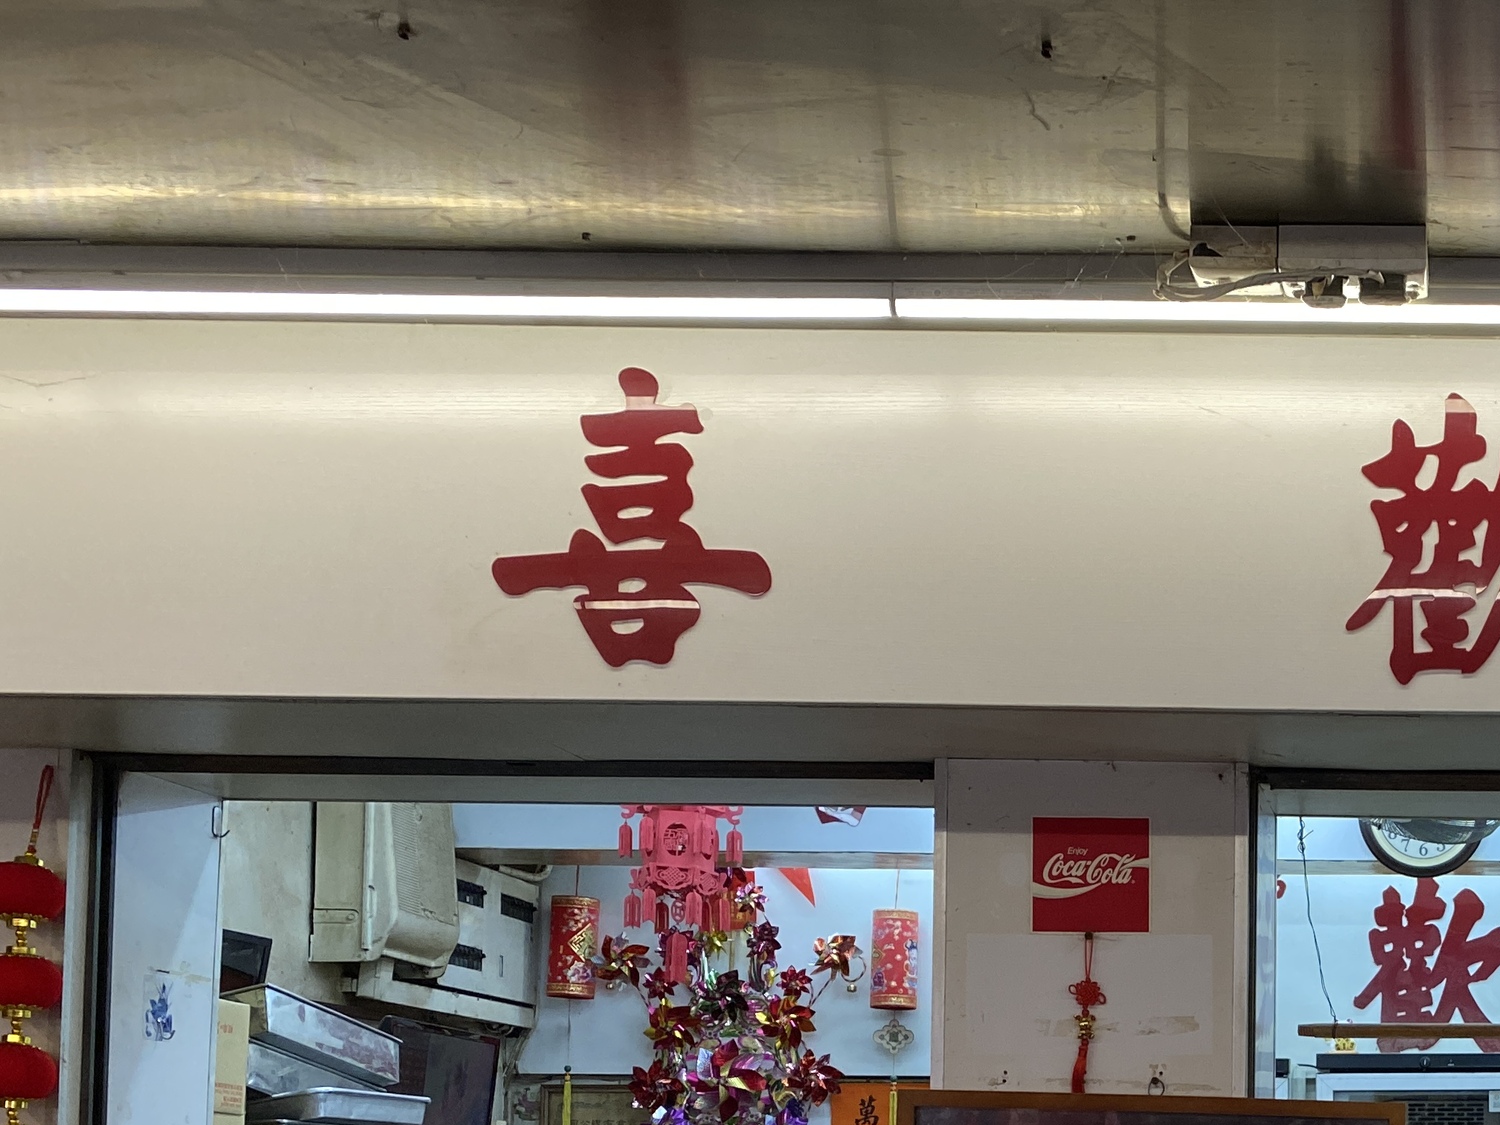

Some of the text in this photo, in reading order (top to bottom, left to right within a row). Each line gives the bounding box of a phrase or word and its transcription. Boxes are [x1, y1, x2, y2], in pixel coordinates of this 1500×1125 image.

[491, 367, 772, 669] 喜
[1067, 846, 1088, 856] Enjoy
[1419, 842, 1428, 856] 6
[1042, 852, 1136, 885] Coca-Cola
